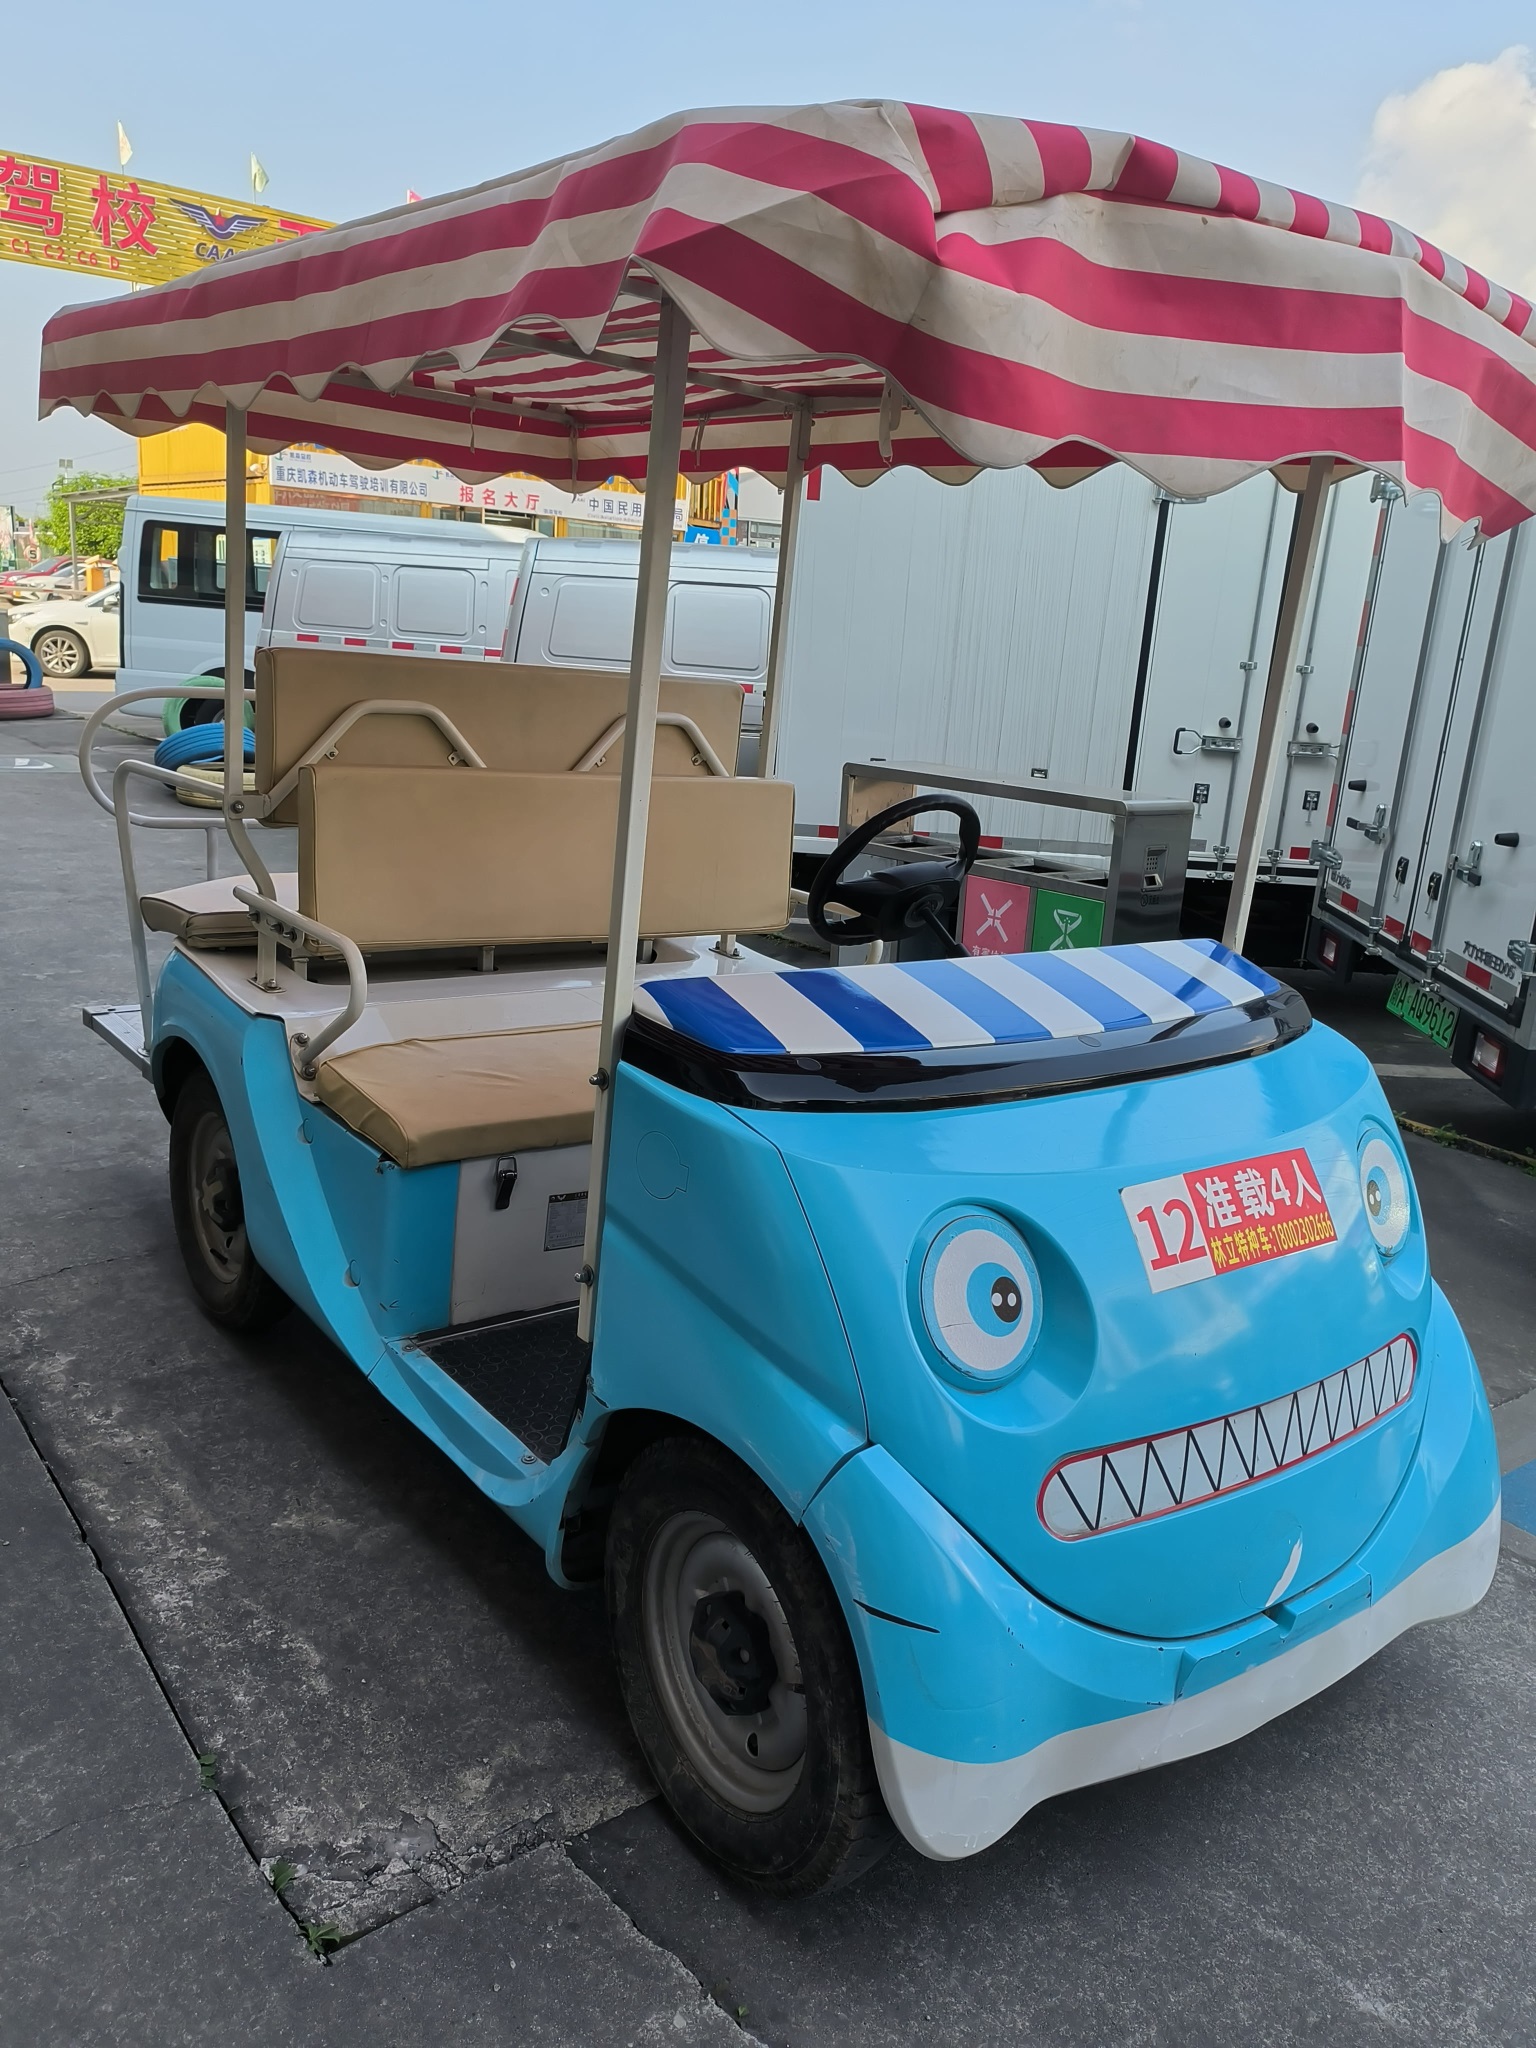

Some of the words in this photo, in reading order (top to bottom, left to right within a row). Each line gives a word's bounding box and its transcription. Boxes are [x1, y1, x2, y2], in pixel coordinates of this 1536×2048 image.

[0, 156, 159, 256] 驾校
[11, 238, 31, 254] C1
[43, 244, 65, 261] C2
[77, 250, 98, 266] C6
[109, 256, 120, 270] D
[194, 242, 248, 260] CAA
[275, 465, 428, 497] 重庆凯森机动车驾驶培训有限公司
[459, 485, 540, 511] 报名大厅
[29, 550, 37, 559] 5
[1195, 1159, 1321, 1228] 准载4人
[1136, 1198, 1208, 1271] 12
